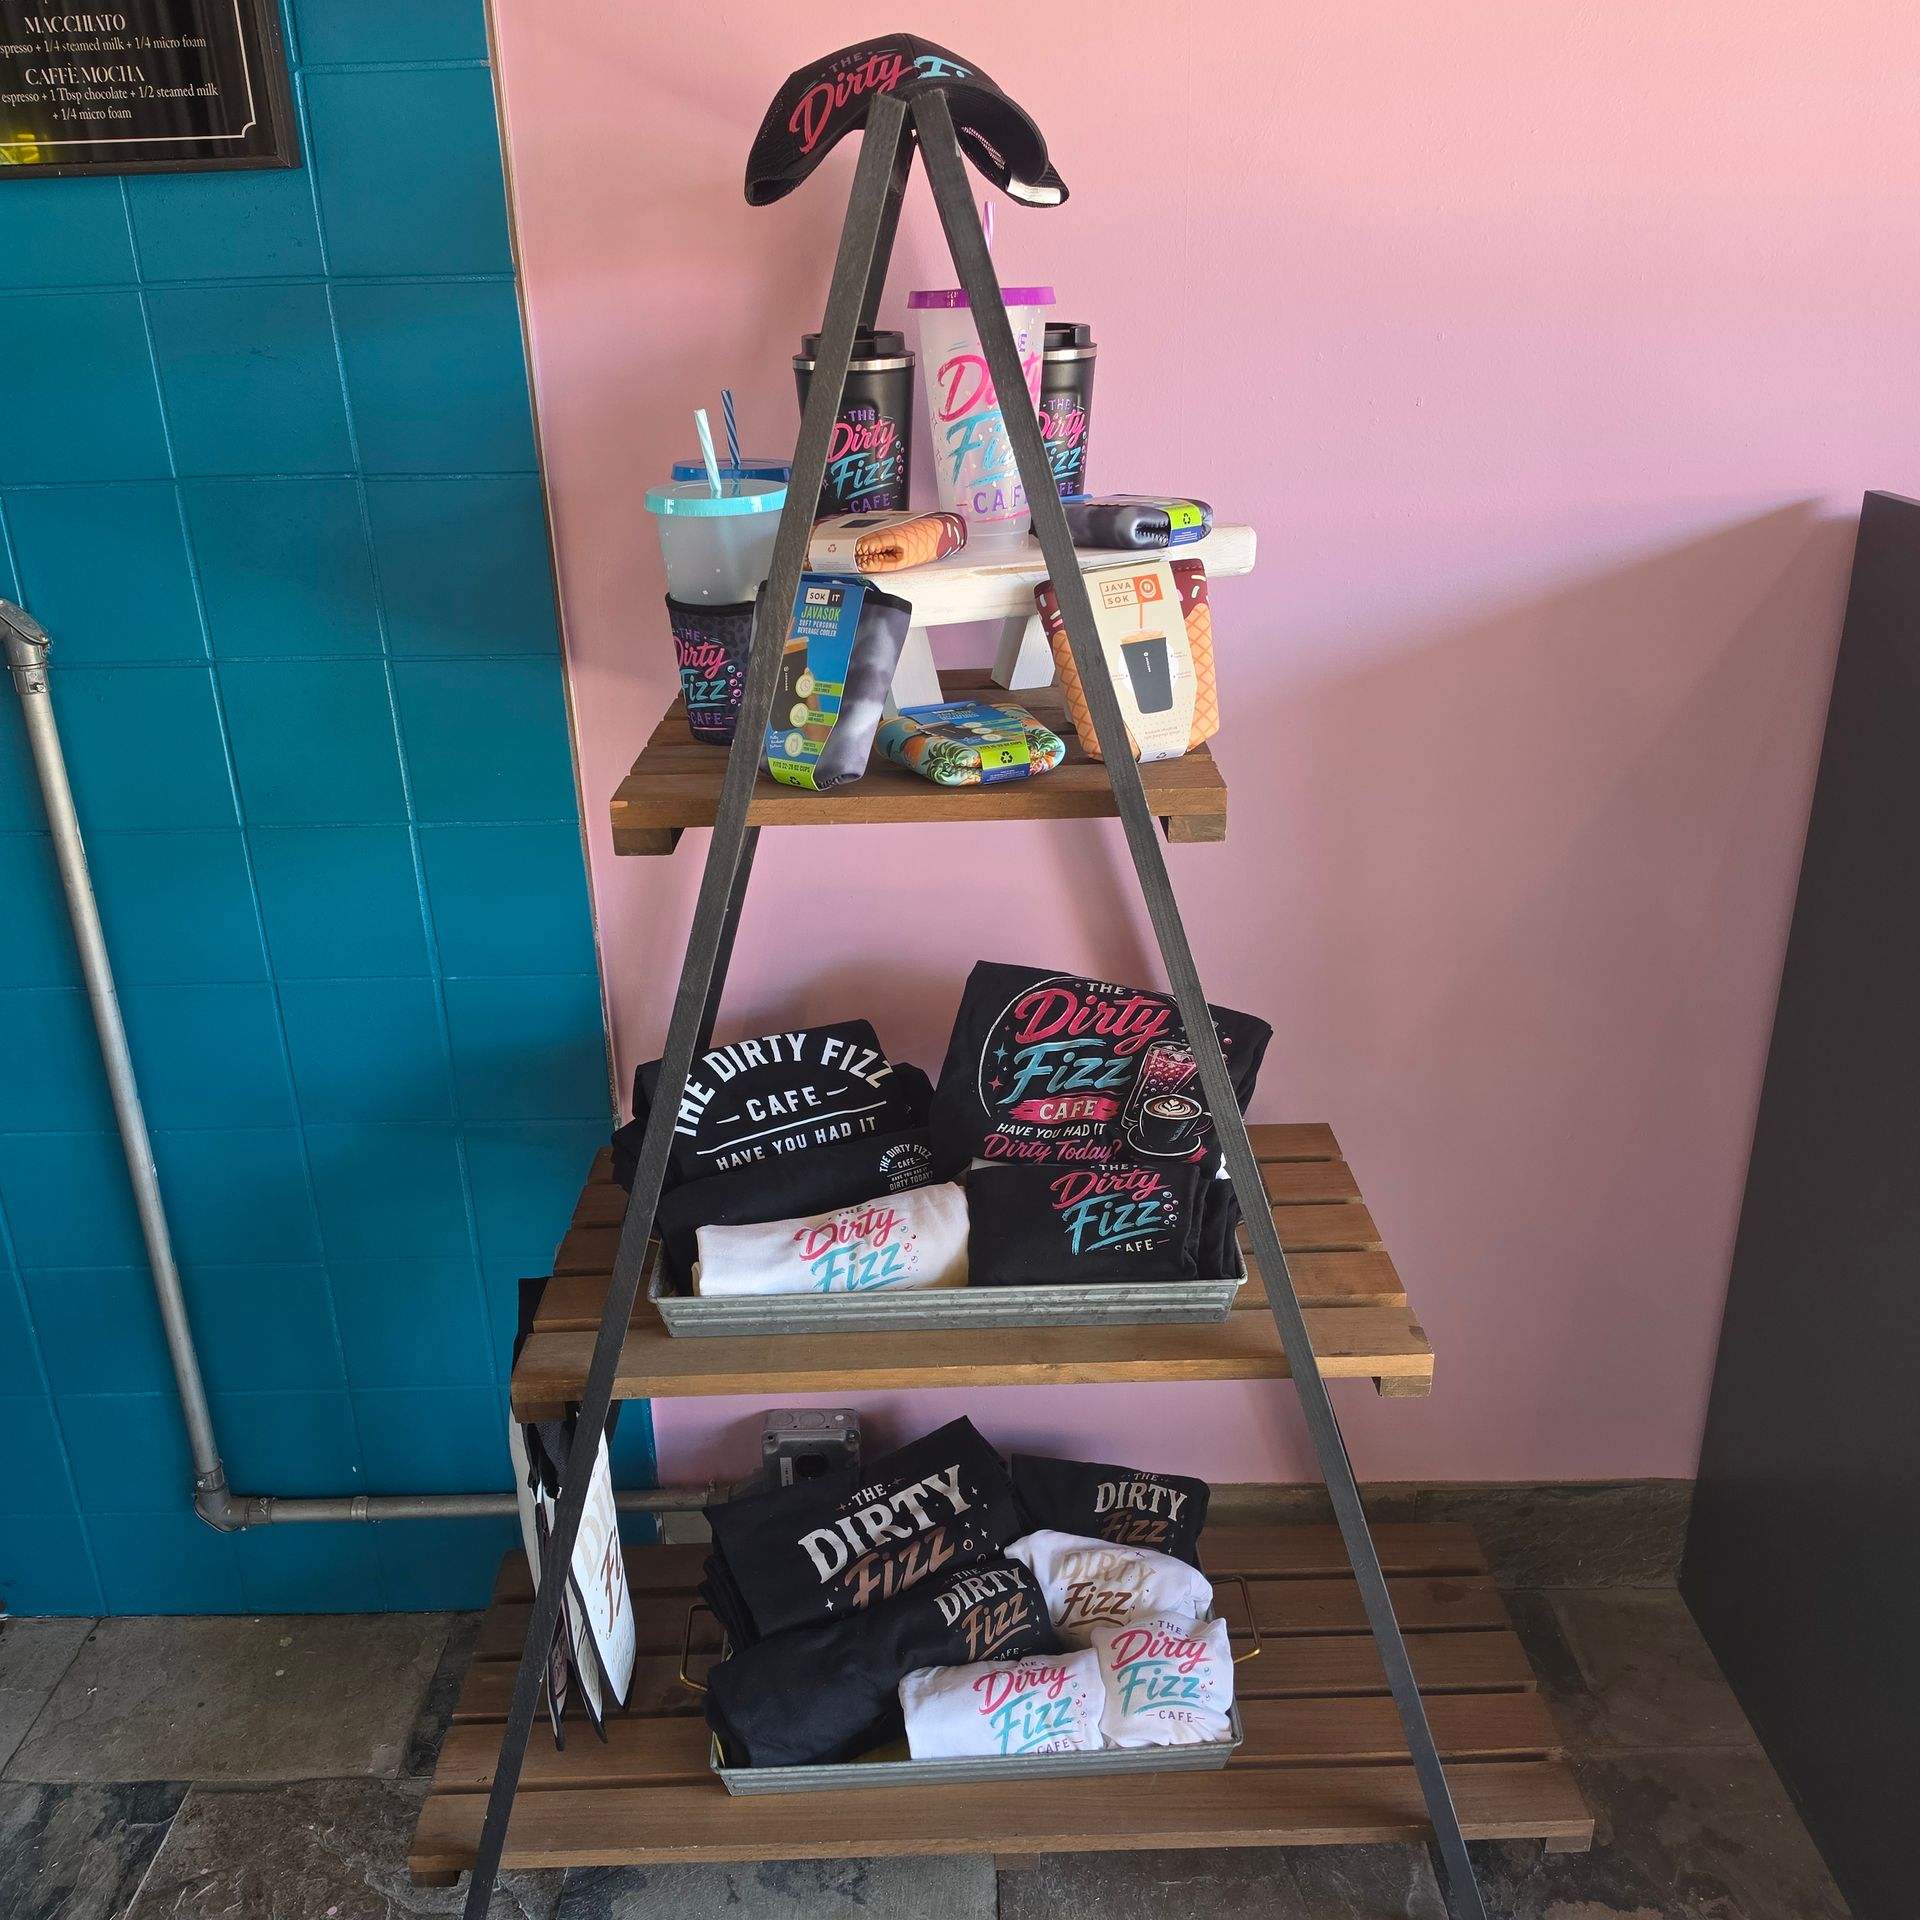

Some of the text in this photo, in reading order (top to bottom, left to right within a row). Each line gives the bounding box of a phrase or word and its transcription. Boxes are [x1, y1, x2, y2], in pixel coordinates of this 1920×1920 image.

[24, 14, 126, 34] MACCHIATO
[0, 43, 33, 58] spresso
[44, 40, 60, 53] 1/4
[62, 37, 100, 52] steamed
[103, 36, 124, 51] milk
[134, 36, 151, 49] 1/4
[153, 36, 180, 49] micro
[182, 34, 207, 48] foam
[25, 62, 145, 86] CAFFÈ MOCHA
[829, 52, 863, 72] THE
[1, 93, 40, 107] espresso
[50, 89, 55, 101] 1
[57, 87, 82, 105] Tbsp
[84, 86, 128, 100] chocolate
[139, 85, 154, 98] 1/2
[156, 83, 194, 97] steamed
[196, 82, 219, 96] milk
[789, 53, 915, 154] Dirty
[61, 107, 77, 121] 1/4
[79, 107, 105, 120] micro
[107, 105, 132, 119] foam
[848, 409, 876, 421] THE
[1048, 399, 1071, 411] THE
[828, 419, 899, 463] Dirty
[1043, 440, 1081, 474] izz
[830, 452, 896, 500] Fizz
[851, 493, 891, 513] CAFE
[973, 484, 1029, 514] CAF
[809, 592, 841, 602] SOK IT
[1104, 582, 1132, 593] JAVA
[1107, 595, 1130, 605] SOK
[801, 606, 841, 621] JAVASOK
[813, 620, 838, 630] PERSONAL
[680, 628, 700, 641] THE
[820, 629, 837, 637] COOLER
[680, 668, 728, 701] Fizz
[690, 711, 723, 725] CAFE
[1086, 982, 1125, 997] THE
[1014, 988, 1172, 1056] Dirty
[702, 1033, 807, 1083] DIRTY
[820, 1036, 894, 1089] FIZZ
[995, 1038, 1133, 1106] Fizz
[745, 1085, 823, 1122] CAFE
[1039, 1099, 1099, 1121] CAFE
[715, 1116, 877, 1171] HAVE YOU HAD IT
[996, 1123, 1107, 1139] HAVE YOU HAD IT
[880, 1143, 932, 1172] THE DIRTY FIZZ
[897, 1157, 915, 1169] CAFE
[984, 1134, 1123, 1165] Dirty Today?
[889, 1170, 933, 1191] DIRTY TODAY?
[1099, 1163, 1129, 1171] THE
[1050, 1168, 1172, 1209] Dirty
[793, 1208, 906, 1261] Dirty
[1062, 1192, 1163, 1256] Fizz
[810, 1241, 905, 1294] Fizz
[1133, 1472, 1160, 1482] THE
[851, 1483, 887, 1507] THE
[1094, 1481, 1188, 1522] DIRTY
[797, 1464, 972, 1584] DIRTY
[1102, 1509, 1169, 1543] Fizz
[844, 1525, 956, 1611] Fizz
[953, 1568, 981, 1581] THE
[1061, 1550, 1156, 1591] DIRTY
[933, 1567, 1028, 1627] DIRTY
[1053, 1582, 1133, 1627] Fizz
[961, 1591, 1029, 1663] Fizz
[1158, 1620, 1183, 1635] THE
[1110, 1629, 1214, 1674] Dirty
[972, 1666, 1078, 1715] Dirty
[1117, 1660, 1201, 1718] Fizz
[990, 1690, 1076, 1757] Fizz
[1159, 1710, 1193, 1723] CAFE
[1037, 1738, 1070, 1754] CAFE
